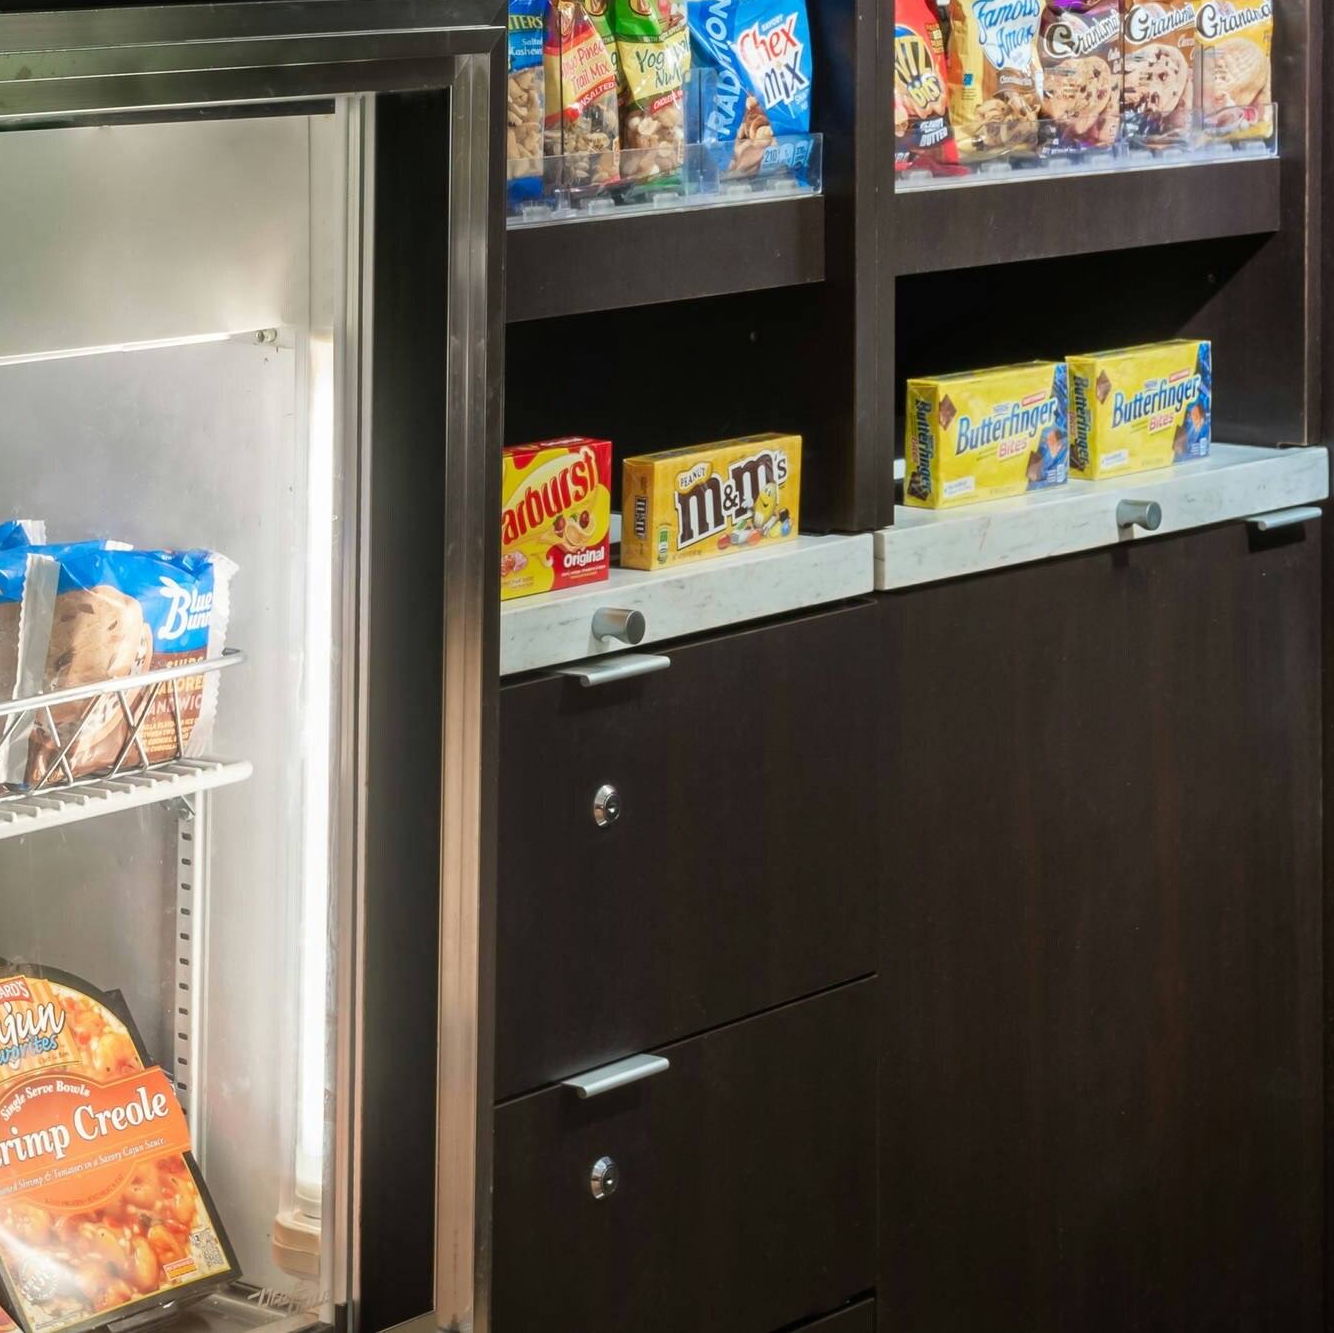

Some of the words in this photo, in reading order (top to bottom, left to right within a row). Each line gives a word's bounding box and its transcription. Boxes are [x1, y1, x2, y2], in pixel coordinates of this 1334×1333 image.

[739, 16, 798, 70] Chex
[996, 23, 1036, 68] Amos
[919, 127, 949, 147] BUTTER
[1073, 372, 1091, 471] Butterfinger
[1111, 374, 1200, 429] Butterfinger
[1148, 412, 1175, 432] Bites
[916, 396, 933, 498] Butterfinger
[954, 398, 1057, 457] Butterfinger
[998, 438, 1029, 458] Bites
[501, 451, 597, 545] arburst
[680, 466, 707, 488] PEANUT
[563, 546, 605, 568] Original
[159, 578, 213, 615] Blue
[157, 612, 211, 640] Bunn
[0, 1092, 26, 1122] Single
[26, 1082, 54, 1100] Serve
[55, 1080, 91, 1097] Bowls
[73, 1086, 169, 1141] Creole
